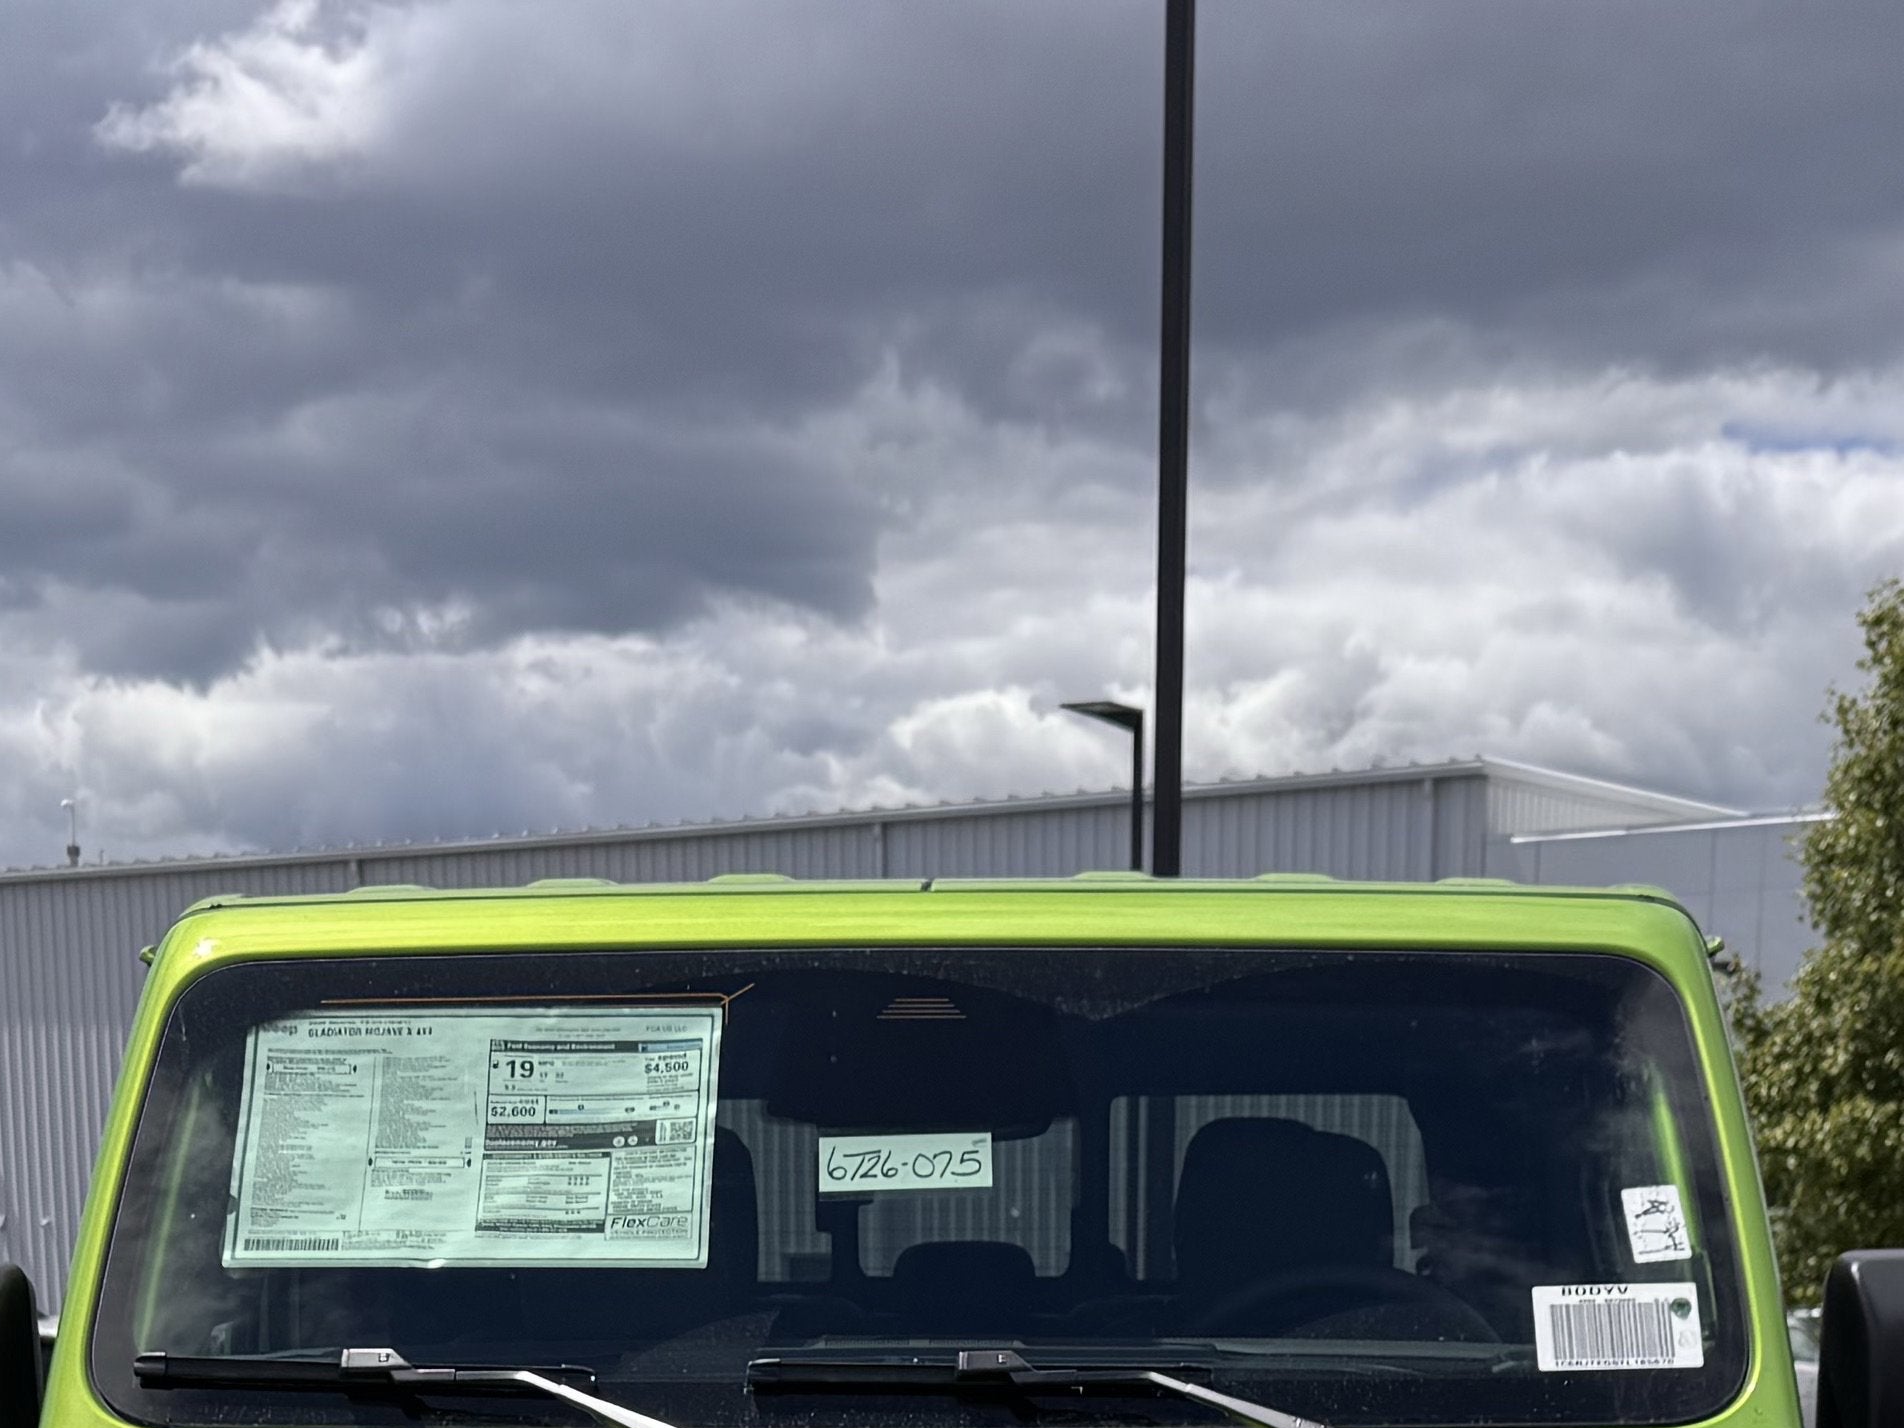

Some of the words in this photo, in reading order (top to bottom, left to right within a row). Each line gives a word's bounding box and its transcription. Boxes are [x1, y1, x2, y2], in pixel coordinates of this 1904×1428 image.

[308, 1026, 362, 1038] GLADIATOR
[505, 1060, 534, 1079] 19
[644, 1061, 689, 1074] $4,500
[490, 1106, 536, 1118] $2,600
[610, 1216, 689, 1229] FlexCare
[1561, 1285, 1629, 1297] BODYV
